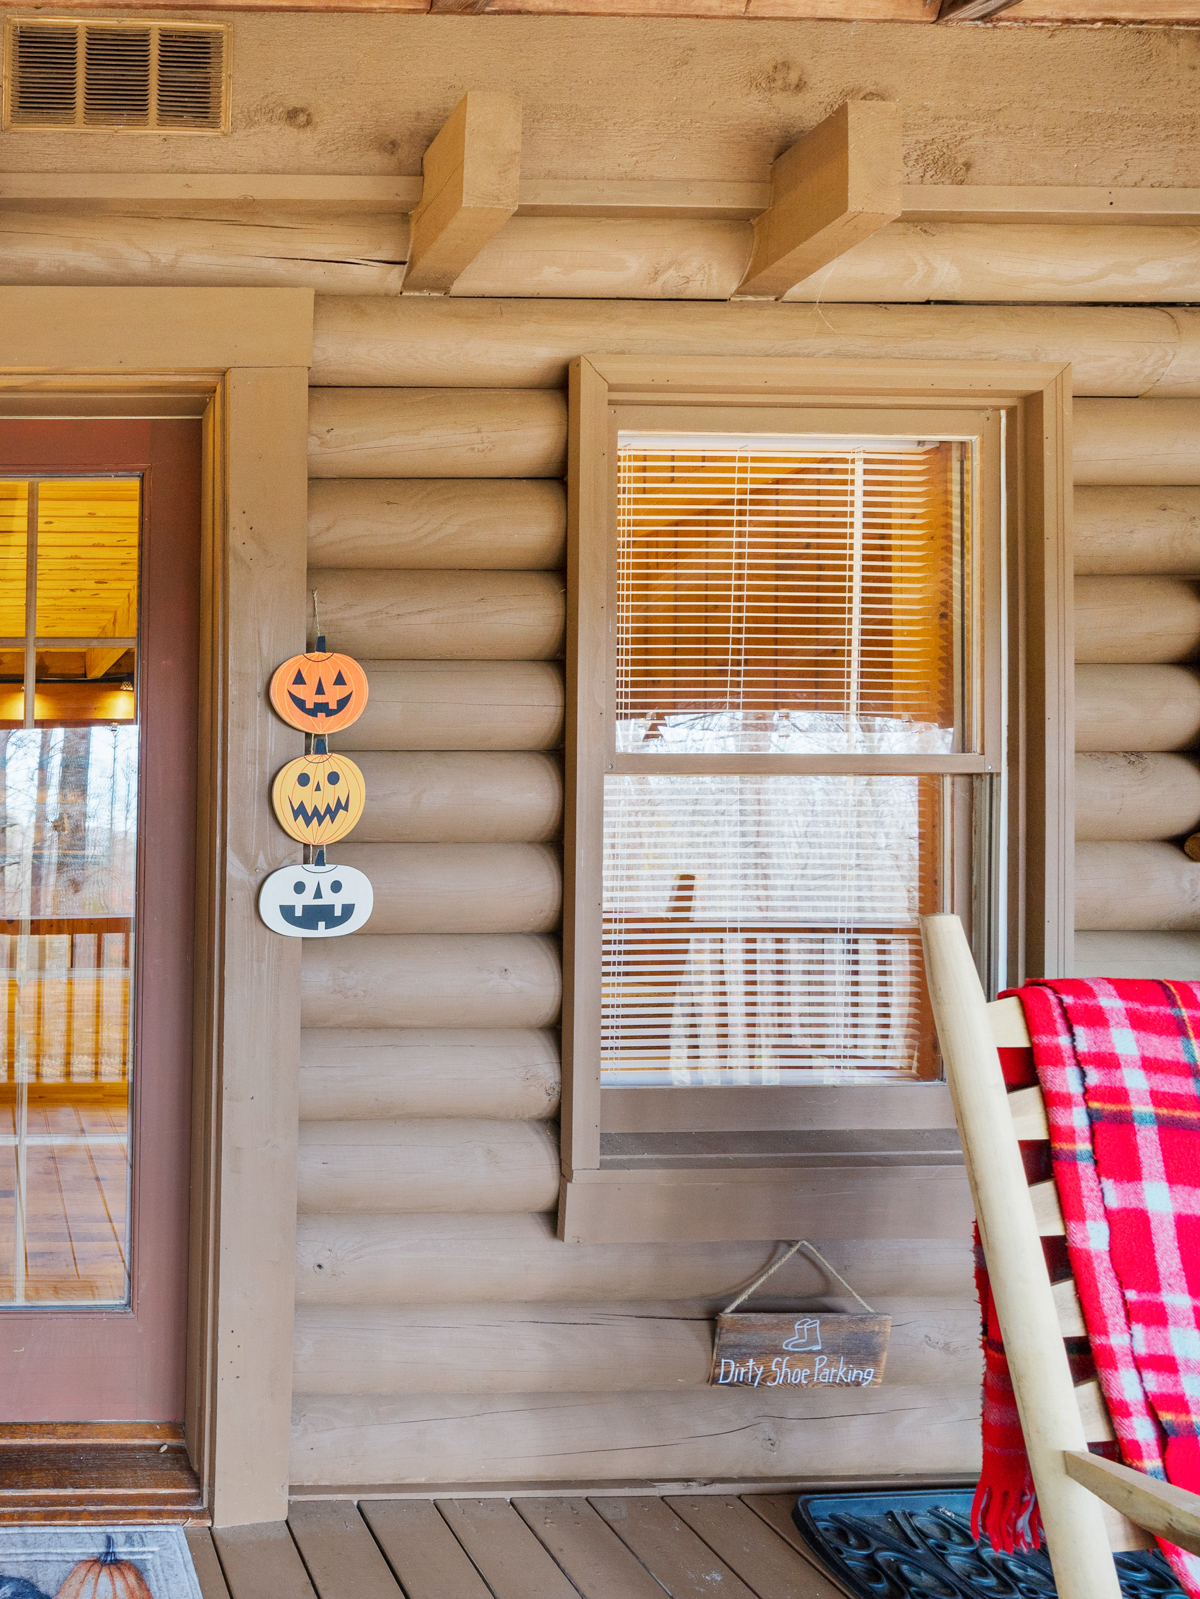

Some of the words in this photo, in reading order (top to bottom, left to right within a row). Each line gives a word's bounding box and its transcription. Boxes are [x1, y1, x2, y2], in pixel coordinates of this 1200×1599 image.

[718, 1358, 764, 1387] Dirty
[767, 1356, 810, 1386] Shoe
[813, 1355, 875, 1386] Parking
